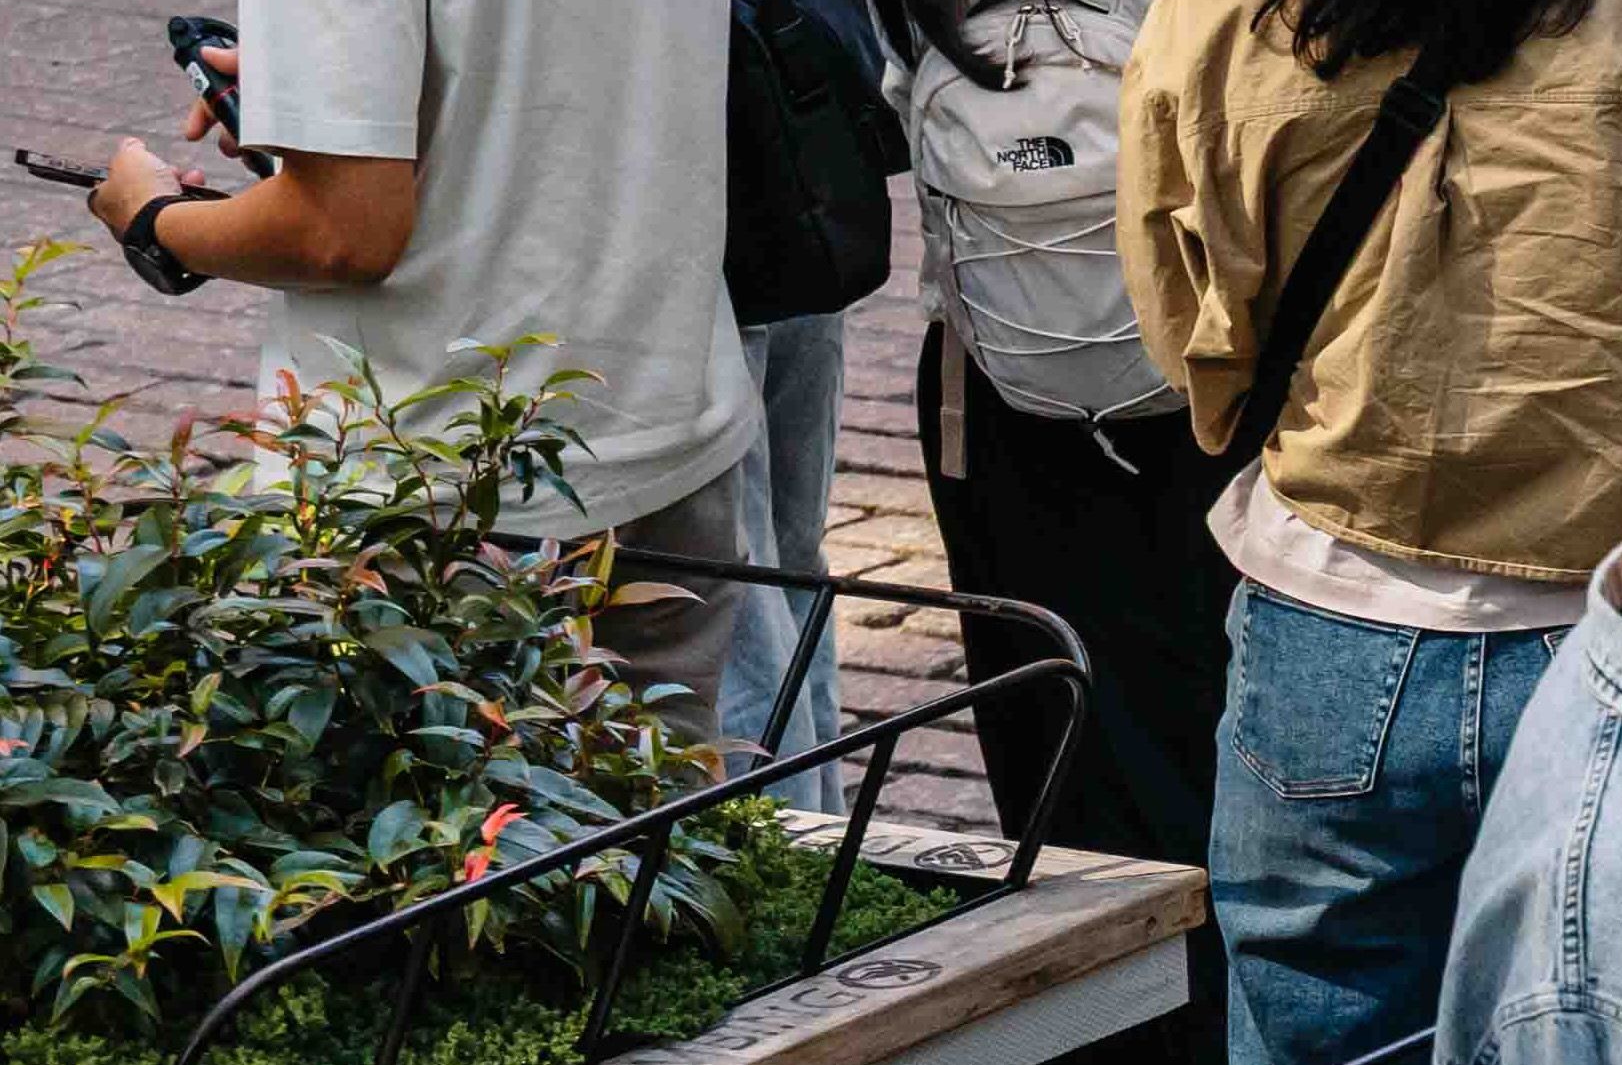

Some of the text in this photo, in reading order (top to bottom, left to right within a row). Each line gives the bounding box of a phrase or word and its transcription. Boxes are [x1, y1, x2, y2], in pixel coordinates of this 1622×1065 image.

[1016, 136, 1046, 153] THE
[996, 147, 1048, 164] NORTH
[1013, 159, 1051, 173] FACE
